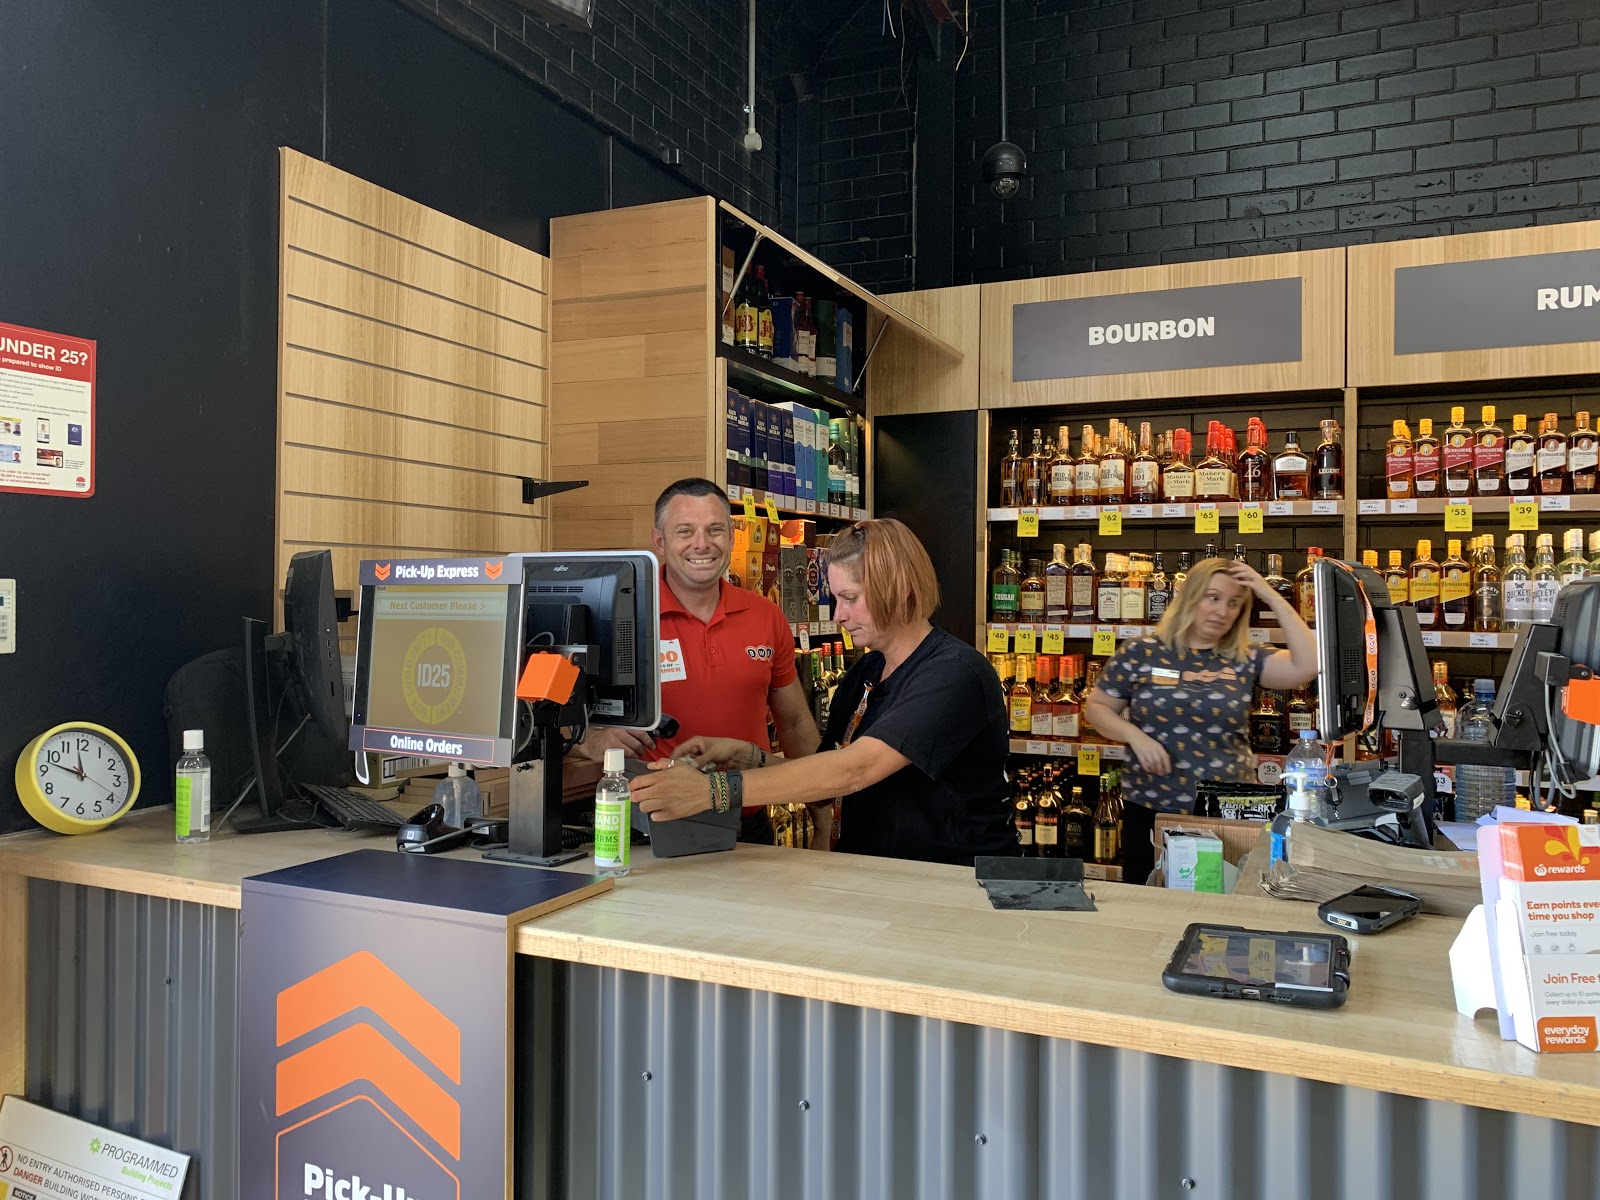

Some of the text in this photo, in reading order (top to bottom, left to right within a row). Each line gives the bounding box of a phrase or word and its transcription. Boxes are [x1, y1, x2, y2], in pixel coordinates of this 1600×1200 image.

[1089, 316, 1214, 346] BOURBON
[2, 357, 30, 367] prepared
[38, 363, 54, 371] show
[60, 349, 88, 366] 25?
[1244, 464, 1261, 478] 46
[1451, 508, 1466, 516] $55
[395, 564, 479, 579] Pick-Up Express
[1476, 586, 1500, 594] BUCKEYE
[1507, 589, 1531, 602] BUCKEYE
[390, 601, 477, 611] Next Customer Please
[1047, 633, 1059, 641] $45
[1098, 634, 1111, 642] $39
[417, 663, 450, 688] ID25
[61, 741, 70, 754] 11
[76, 738, 89, 752] 12
[390, 734, 463, 756] Online Orders
[47, 749, 60, 763] 10
[98, 746, 101, 759] 1
[39, 764, 49, 777] 9
[107, 759, 116, 771] 2
[1263, 765, 1277, 773] $55
[112, 775, 121, 788] 3
[45, 782, 54, 795] 8
[60, 796, 70, 809] 7
[106, 792, 115, 804] 4
[76, 802, 85, 815] 6
[93, 801, 102, 813] 5
[1547, 865, 1586, 874] rewards
[1527, 901, 1550, 910] Earn
[1551, 901, 1581, 911] points
[1528, 911, 1594, 922] time you shop
[1543, 973, 1596, 984] Join Free
[1544, 1025, 1590, 1037] everyday
[1545, 1034, 1586, 1044] rewards
[101, 1143, 179, 1178] PROGRAMMED
[17, 1153, 28, 1165] NO
[29, 1157, 52, 1174] ENTRY
[52, 1165, 100, 1192] AUTHORISED
[121, 1166, 173, 1190] Building Projects
[13, 1167, 79, 1200] DANGER BUILDING
